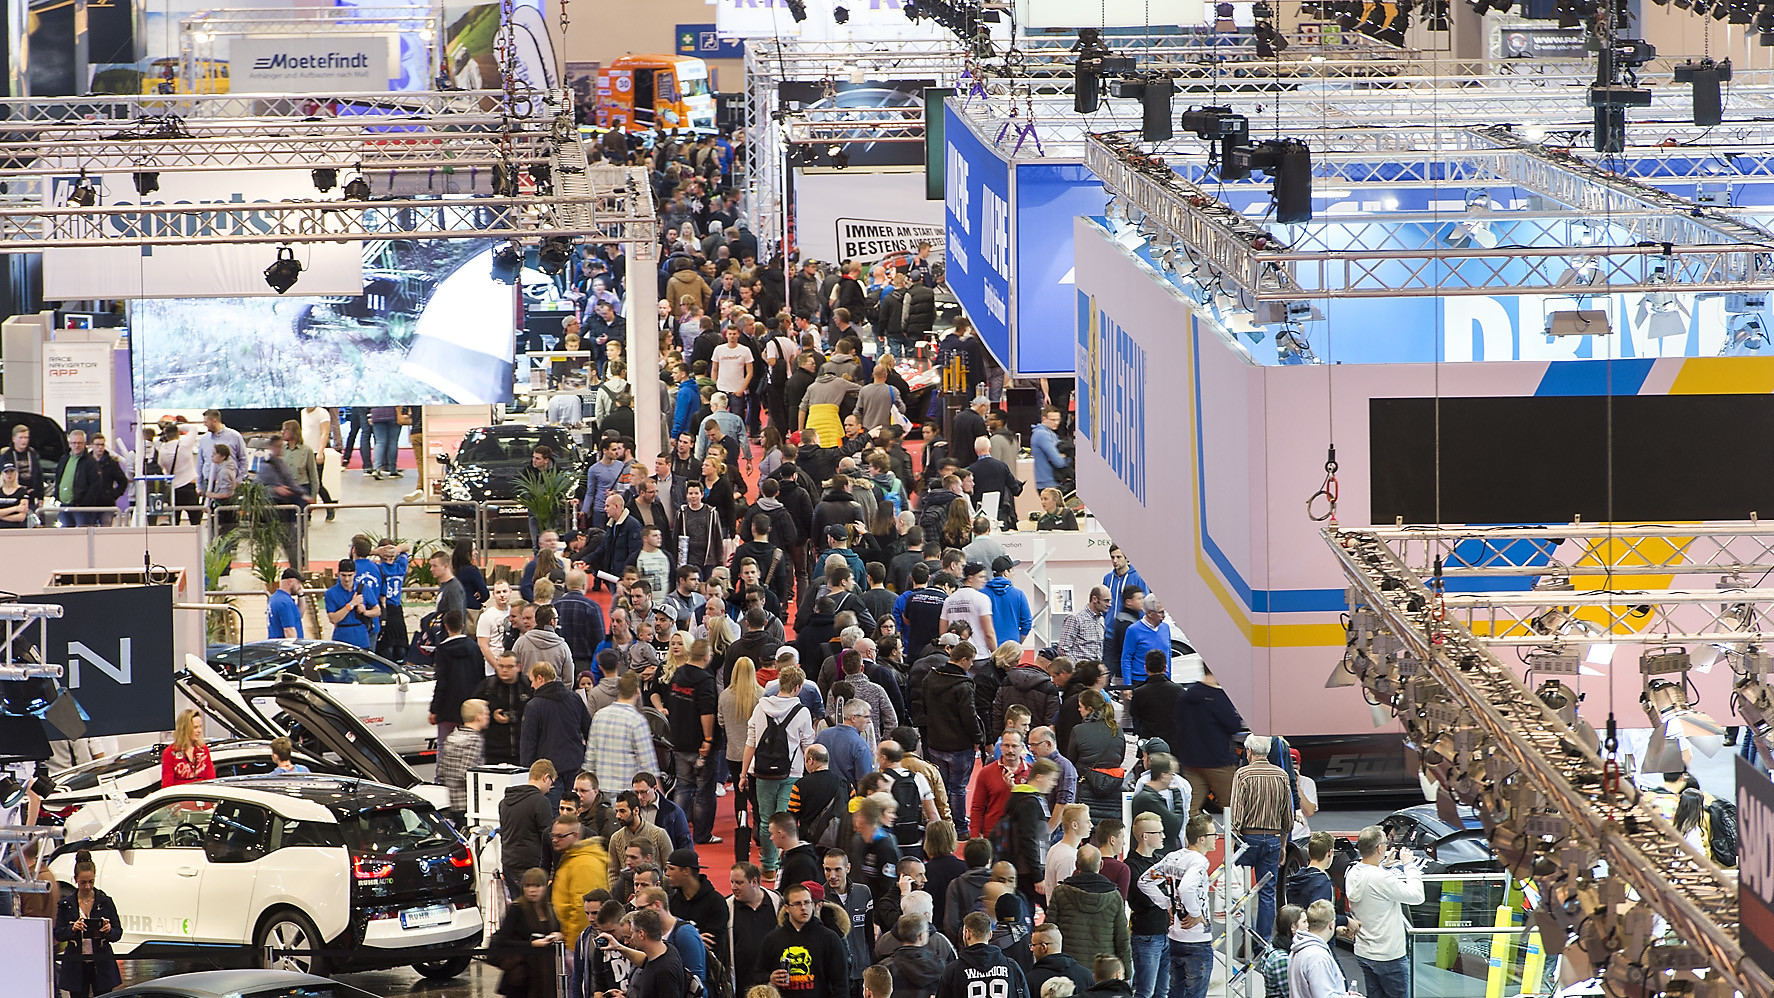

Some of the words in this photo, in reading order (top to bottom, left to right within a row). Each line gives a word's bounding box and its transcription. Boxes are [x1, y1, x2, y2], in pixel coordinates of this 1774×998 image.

[268, 52, 368, 69] Moetefindt
[619, 79, 630, 88] 30
[845, 223, 894, 238] IMMER
[897, 226, 912, 237] AM
[914, 226, 933, 237] START
[845, 238, 907, 258] BESTENS
[1100, 309, 1146, 508] BILSTEIN
[119, 914, 153, 932] UHR
[408, 911, 429, 921] RUHR
